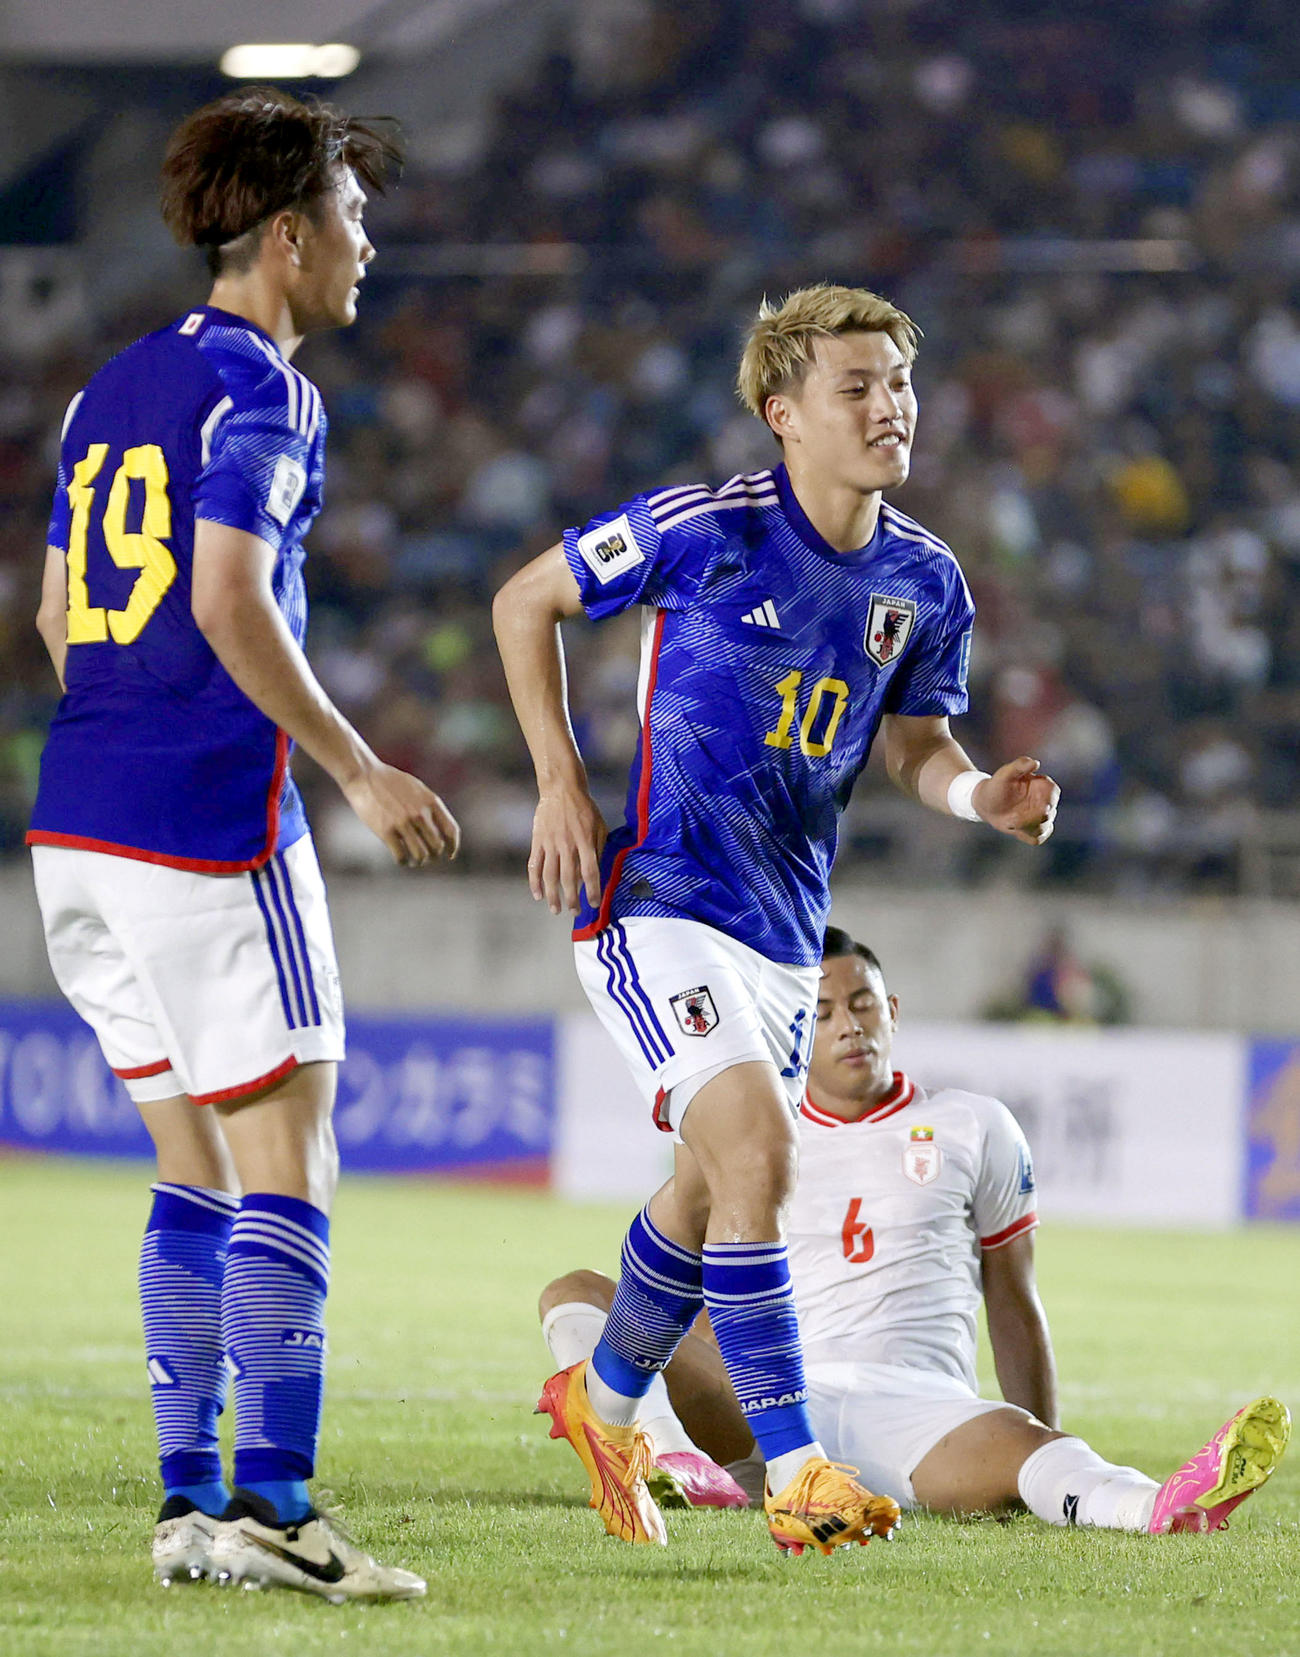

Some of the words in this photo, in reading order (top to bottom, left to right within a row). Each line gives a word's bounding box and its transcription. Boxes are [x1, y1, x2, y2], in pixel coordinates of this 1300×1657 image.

[65, 443, 178, 646] 19
[881, 598, 906, 608] JAPAN
[764, 670, 850, 758] 10
[680, 987, 700, 998] JAPAN
[841, 1197, 875, 1264] 6
[739, 1388, 808, 1415] JAPAN
